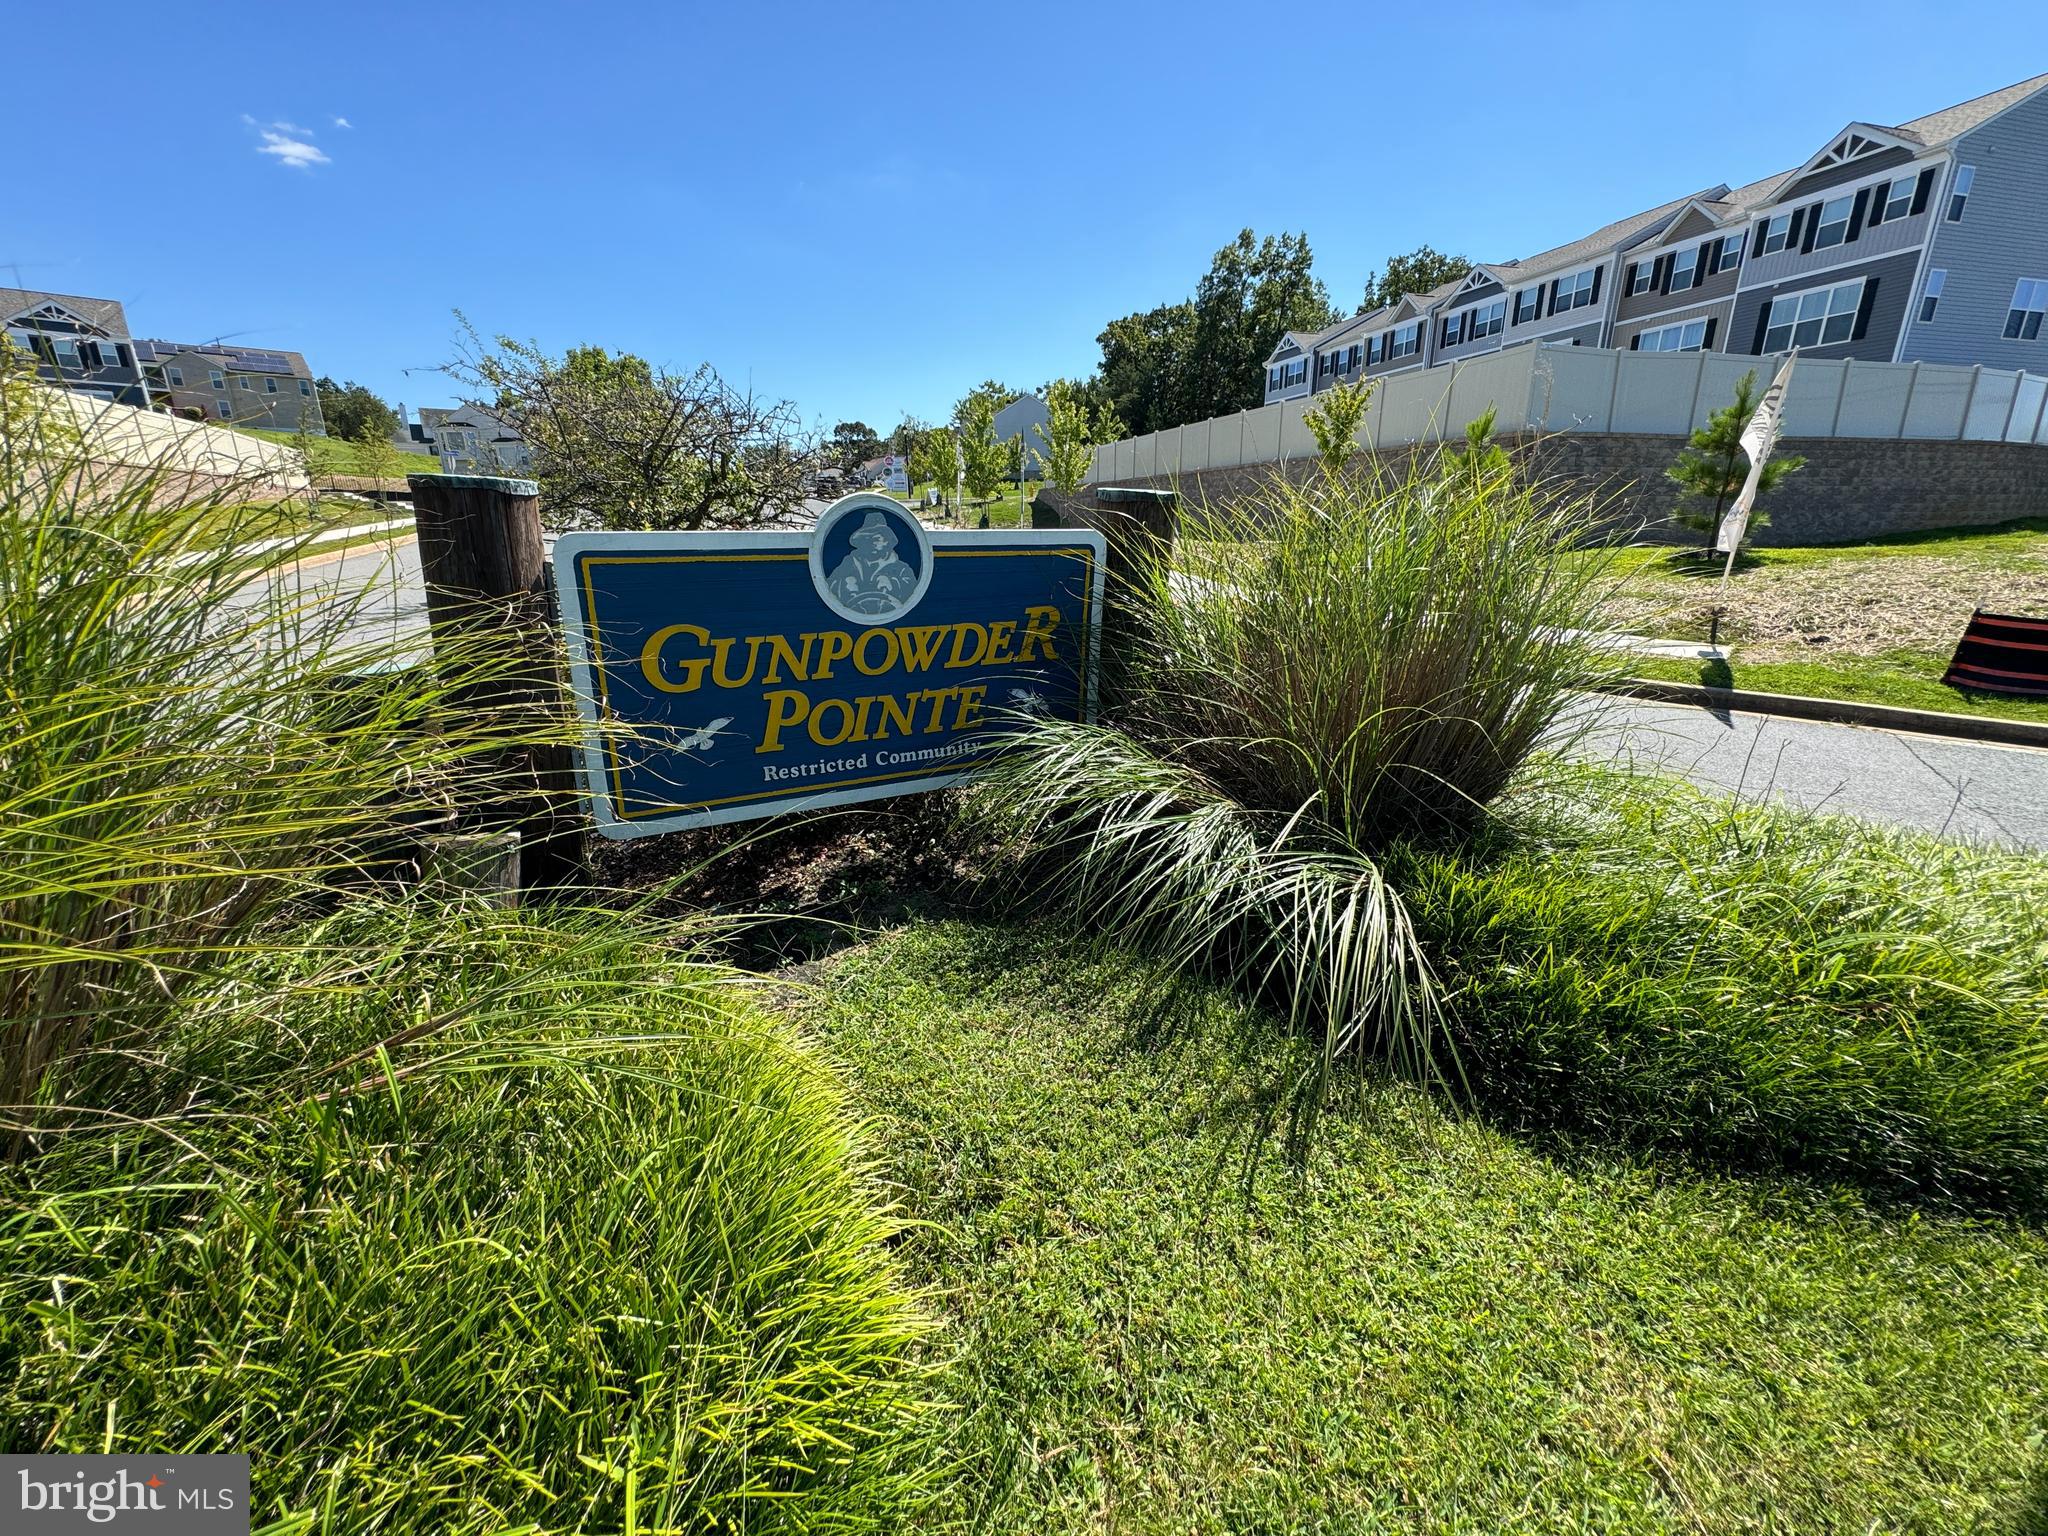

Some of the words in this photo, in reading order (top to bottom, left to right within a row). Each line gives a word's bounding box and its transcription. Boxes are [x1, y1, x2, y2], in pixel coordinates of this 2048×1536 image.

[641, 604, 1062, 693] GUNPOWDER
[755, 685, 987, 754] POINTE
[763, 753, 867, 782] Restricted
[876, 741, 982, 766] Community
